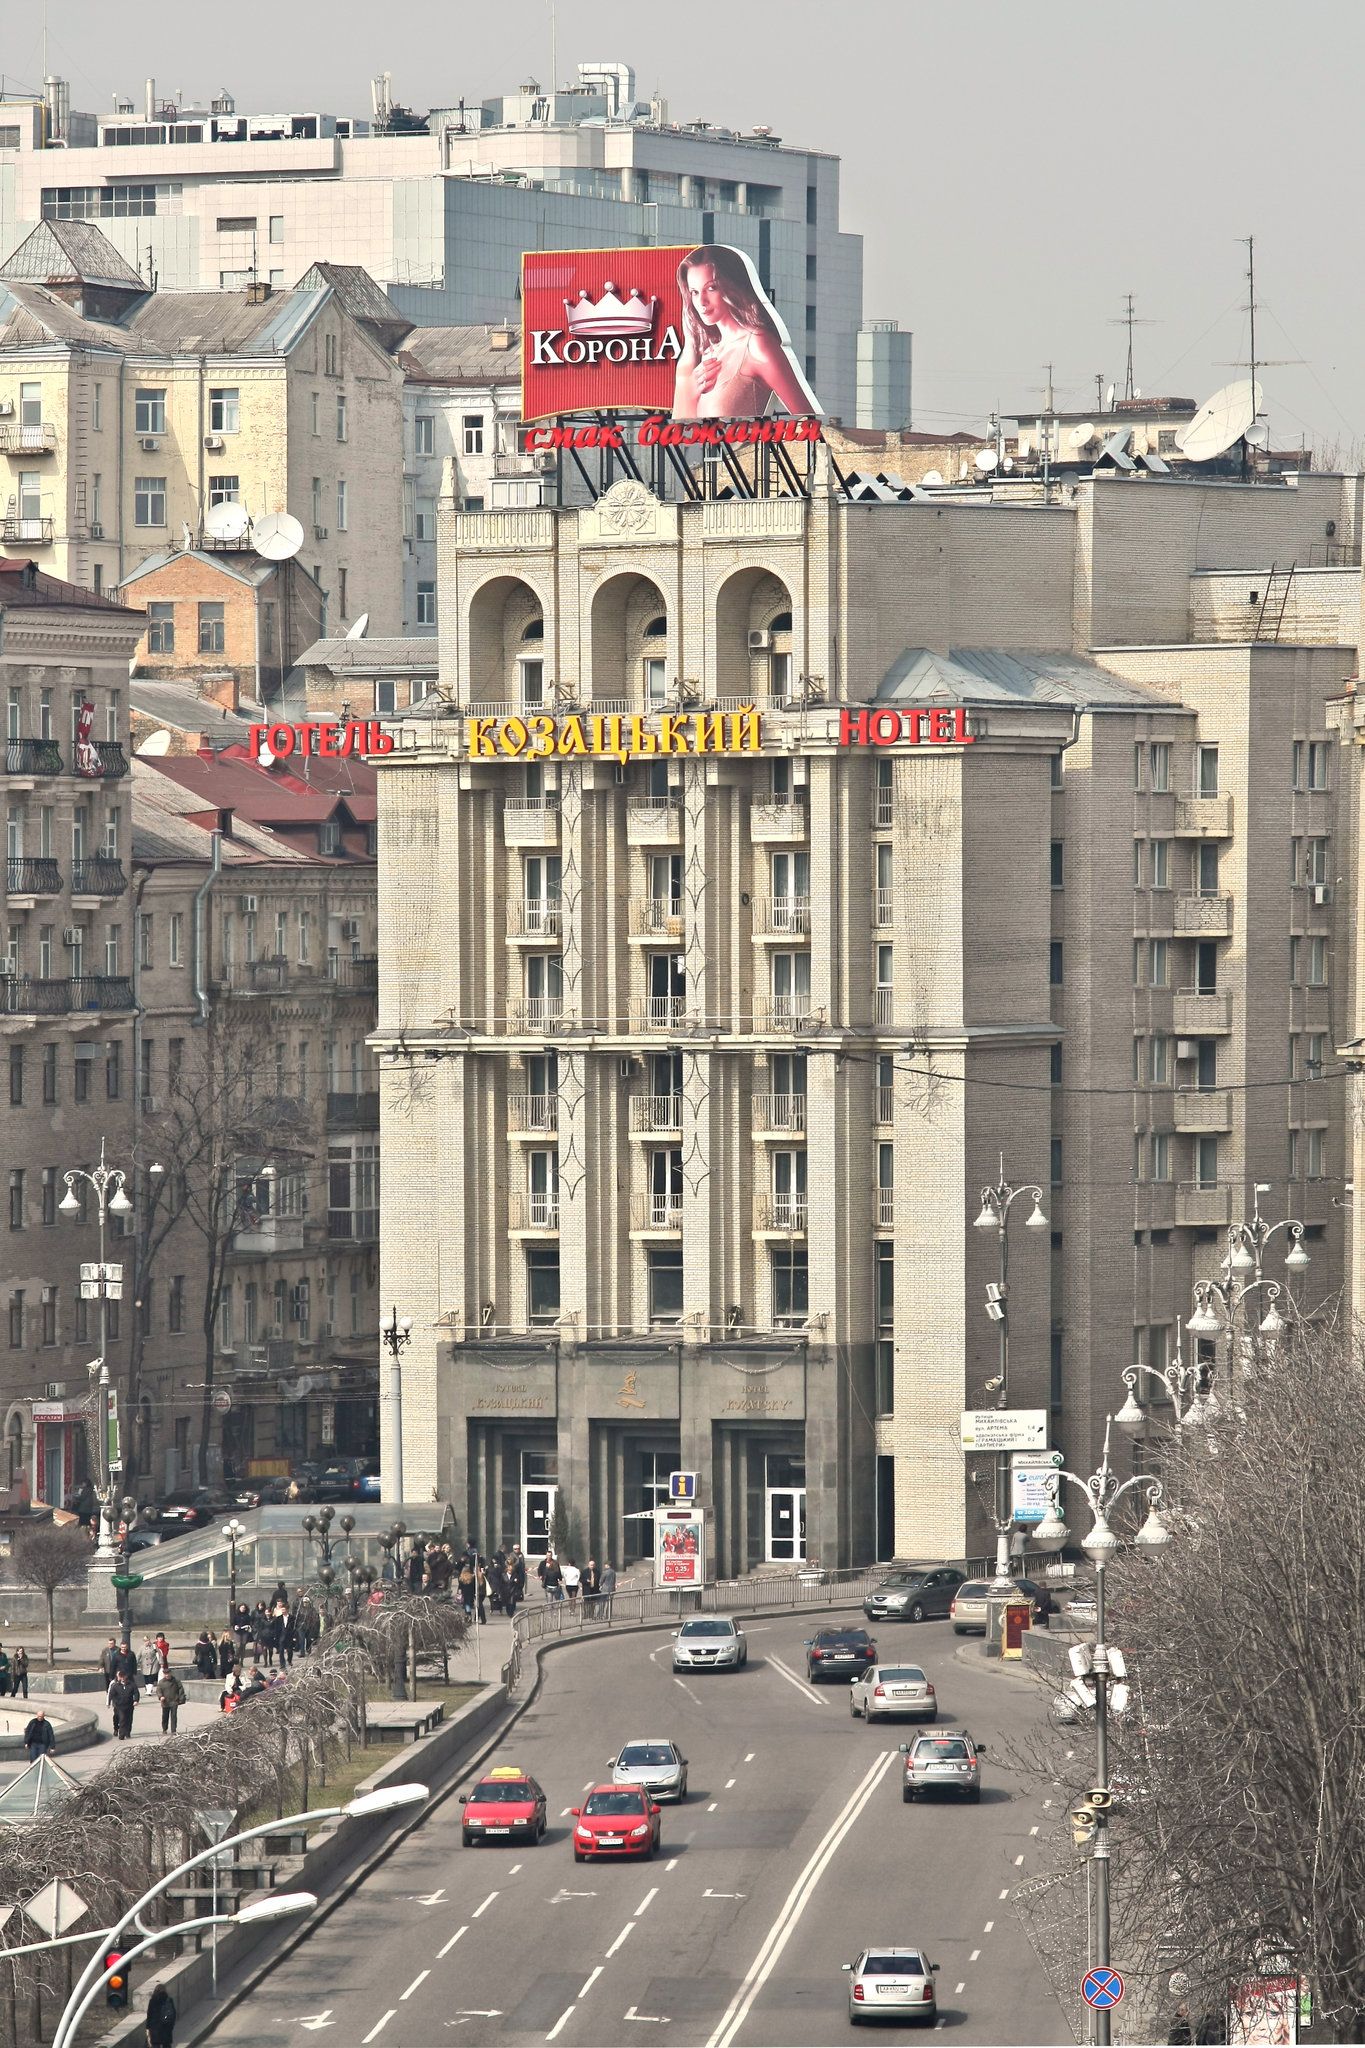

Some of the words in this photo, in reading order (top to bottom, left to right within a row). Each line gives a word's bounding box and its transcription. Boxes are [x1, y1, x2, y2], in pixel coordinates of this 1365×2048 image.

[524, 422, 626, 453] смак
[637, 415, 822, 447] бажання
[248, 721, 395, 759] ГОТЕЛЬ
[467, 703, 763, 765] КОЗАЦЬКИЙ
[839, 707, 976, 747] HOTEL
